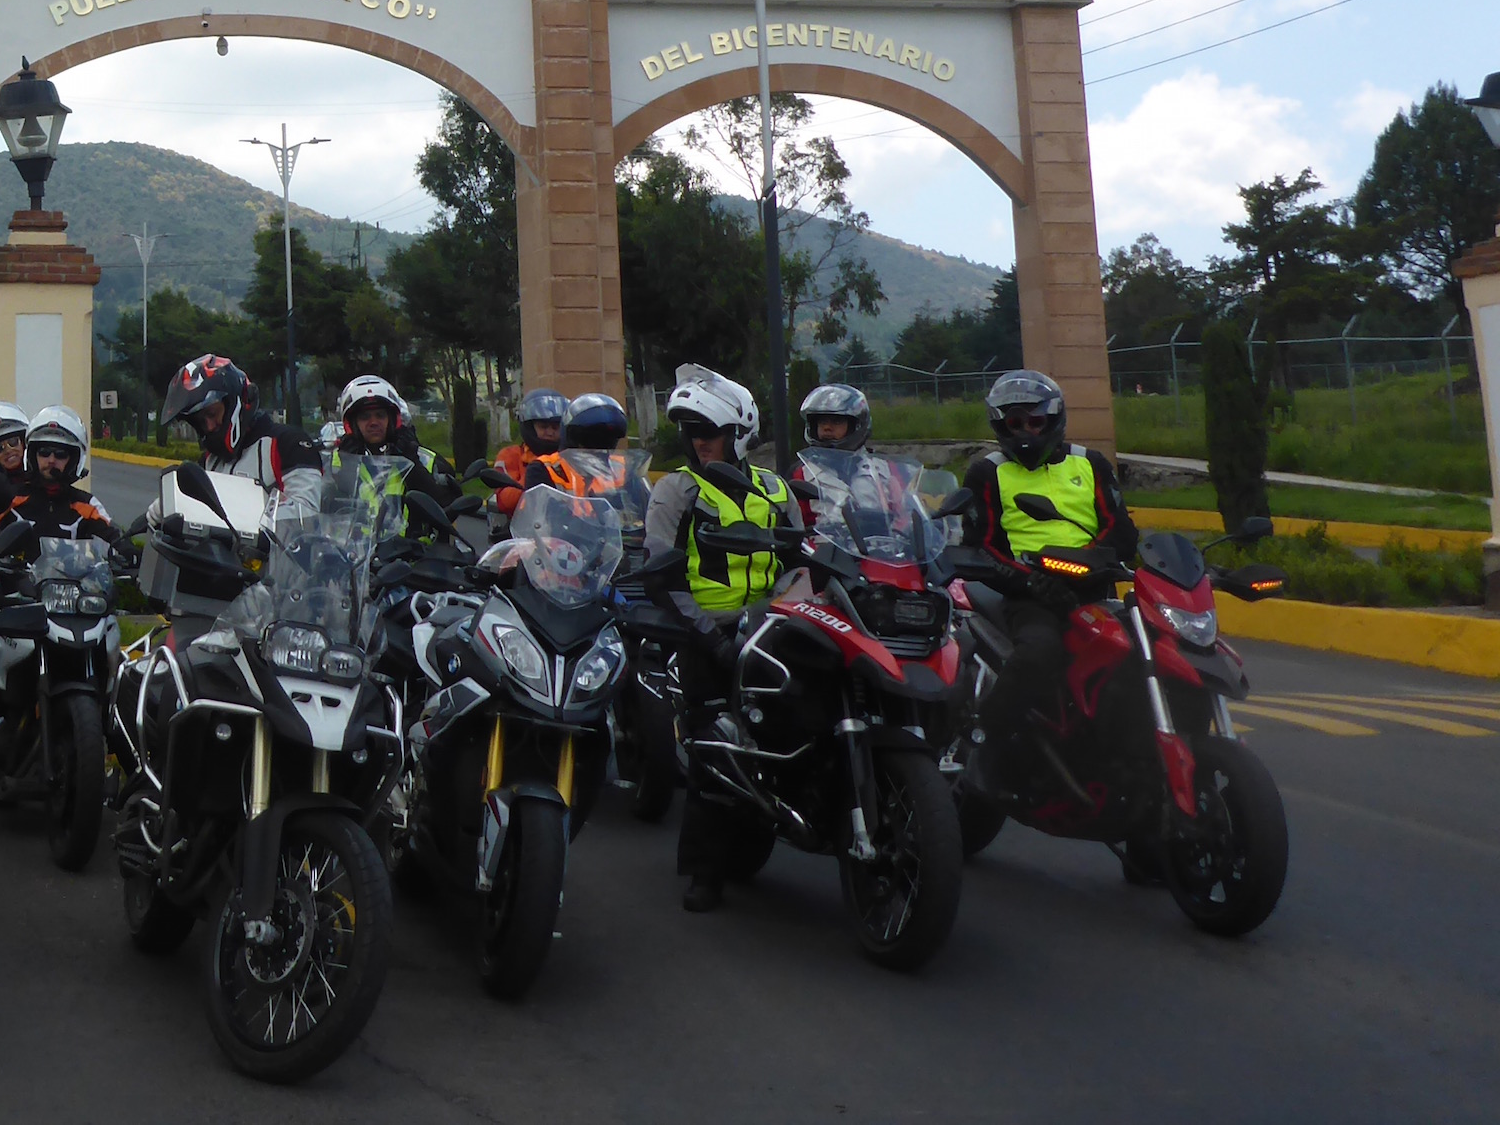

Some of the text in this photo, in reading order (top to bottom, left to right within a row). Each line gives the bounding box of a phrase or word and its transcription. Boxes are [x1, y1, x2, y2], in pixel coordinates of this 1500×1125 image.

[640, 23, 955, 82] DEL BICENTENARIO
[106, 394, 113, 405] E
[793, 602, 853, 633] R1200
